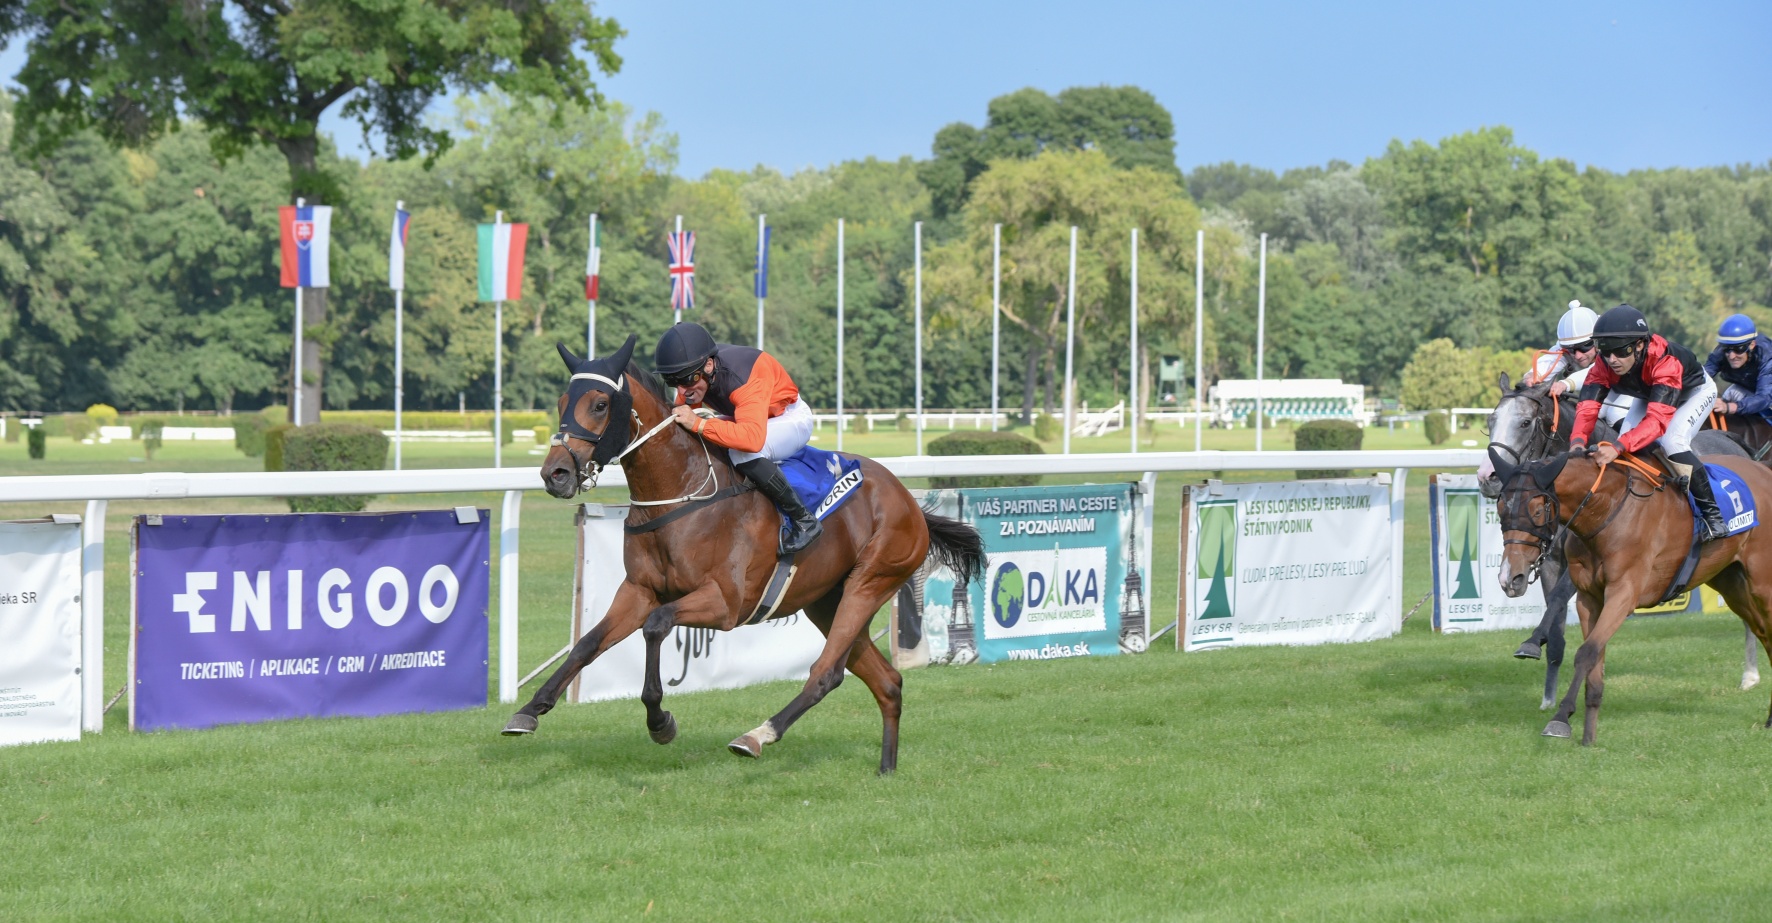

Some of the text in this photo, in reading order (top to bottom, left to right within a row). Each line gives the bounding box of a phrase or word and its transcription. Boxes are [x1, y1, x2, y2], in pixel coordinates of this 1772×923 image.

[1686, 416, 1697, 427] M.
[977, 496, 1117, 515] VÁŠ PARTNER NA CESTE
[1245, 495, 1371, 515] LESY SLOVENSKEJ REPUBLIKY,
[1720, 479, 1743, 515] 6
[1000, 515, 1095, 536] ZA POZNÁVANÍM
[1244, 518, 1313, 536] ŠTÁTNY PODNIK
[1243, 557, 1369, 583] ĽUDIA PRE LESY, LESY PRE ĽUDÍ
[1027, 564, 1098, 609] DAKA
[21, 591, 37, 604] SR
[172, 564, 460, 633] ENIGOO
[1027, 608, 1096, 622] CESTOVNÁ KANCELÁRIA
[1449, 603, 1483, 614] LESY SR
[1192, 622, 1232, 635] LESY SR
[1301, 617, 1324, 631] partner
[1007, 641, 1091, 660] www.daka.sk
[180, 661, 245, 680] TICKETING
[260, 658, 320, 676] APLIKACE
[337, 656, 365, 673] CRM
[380, 650, 446, 671] AKREDITACE
